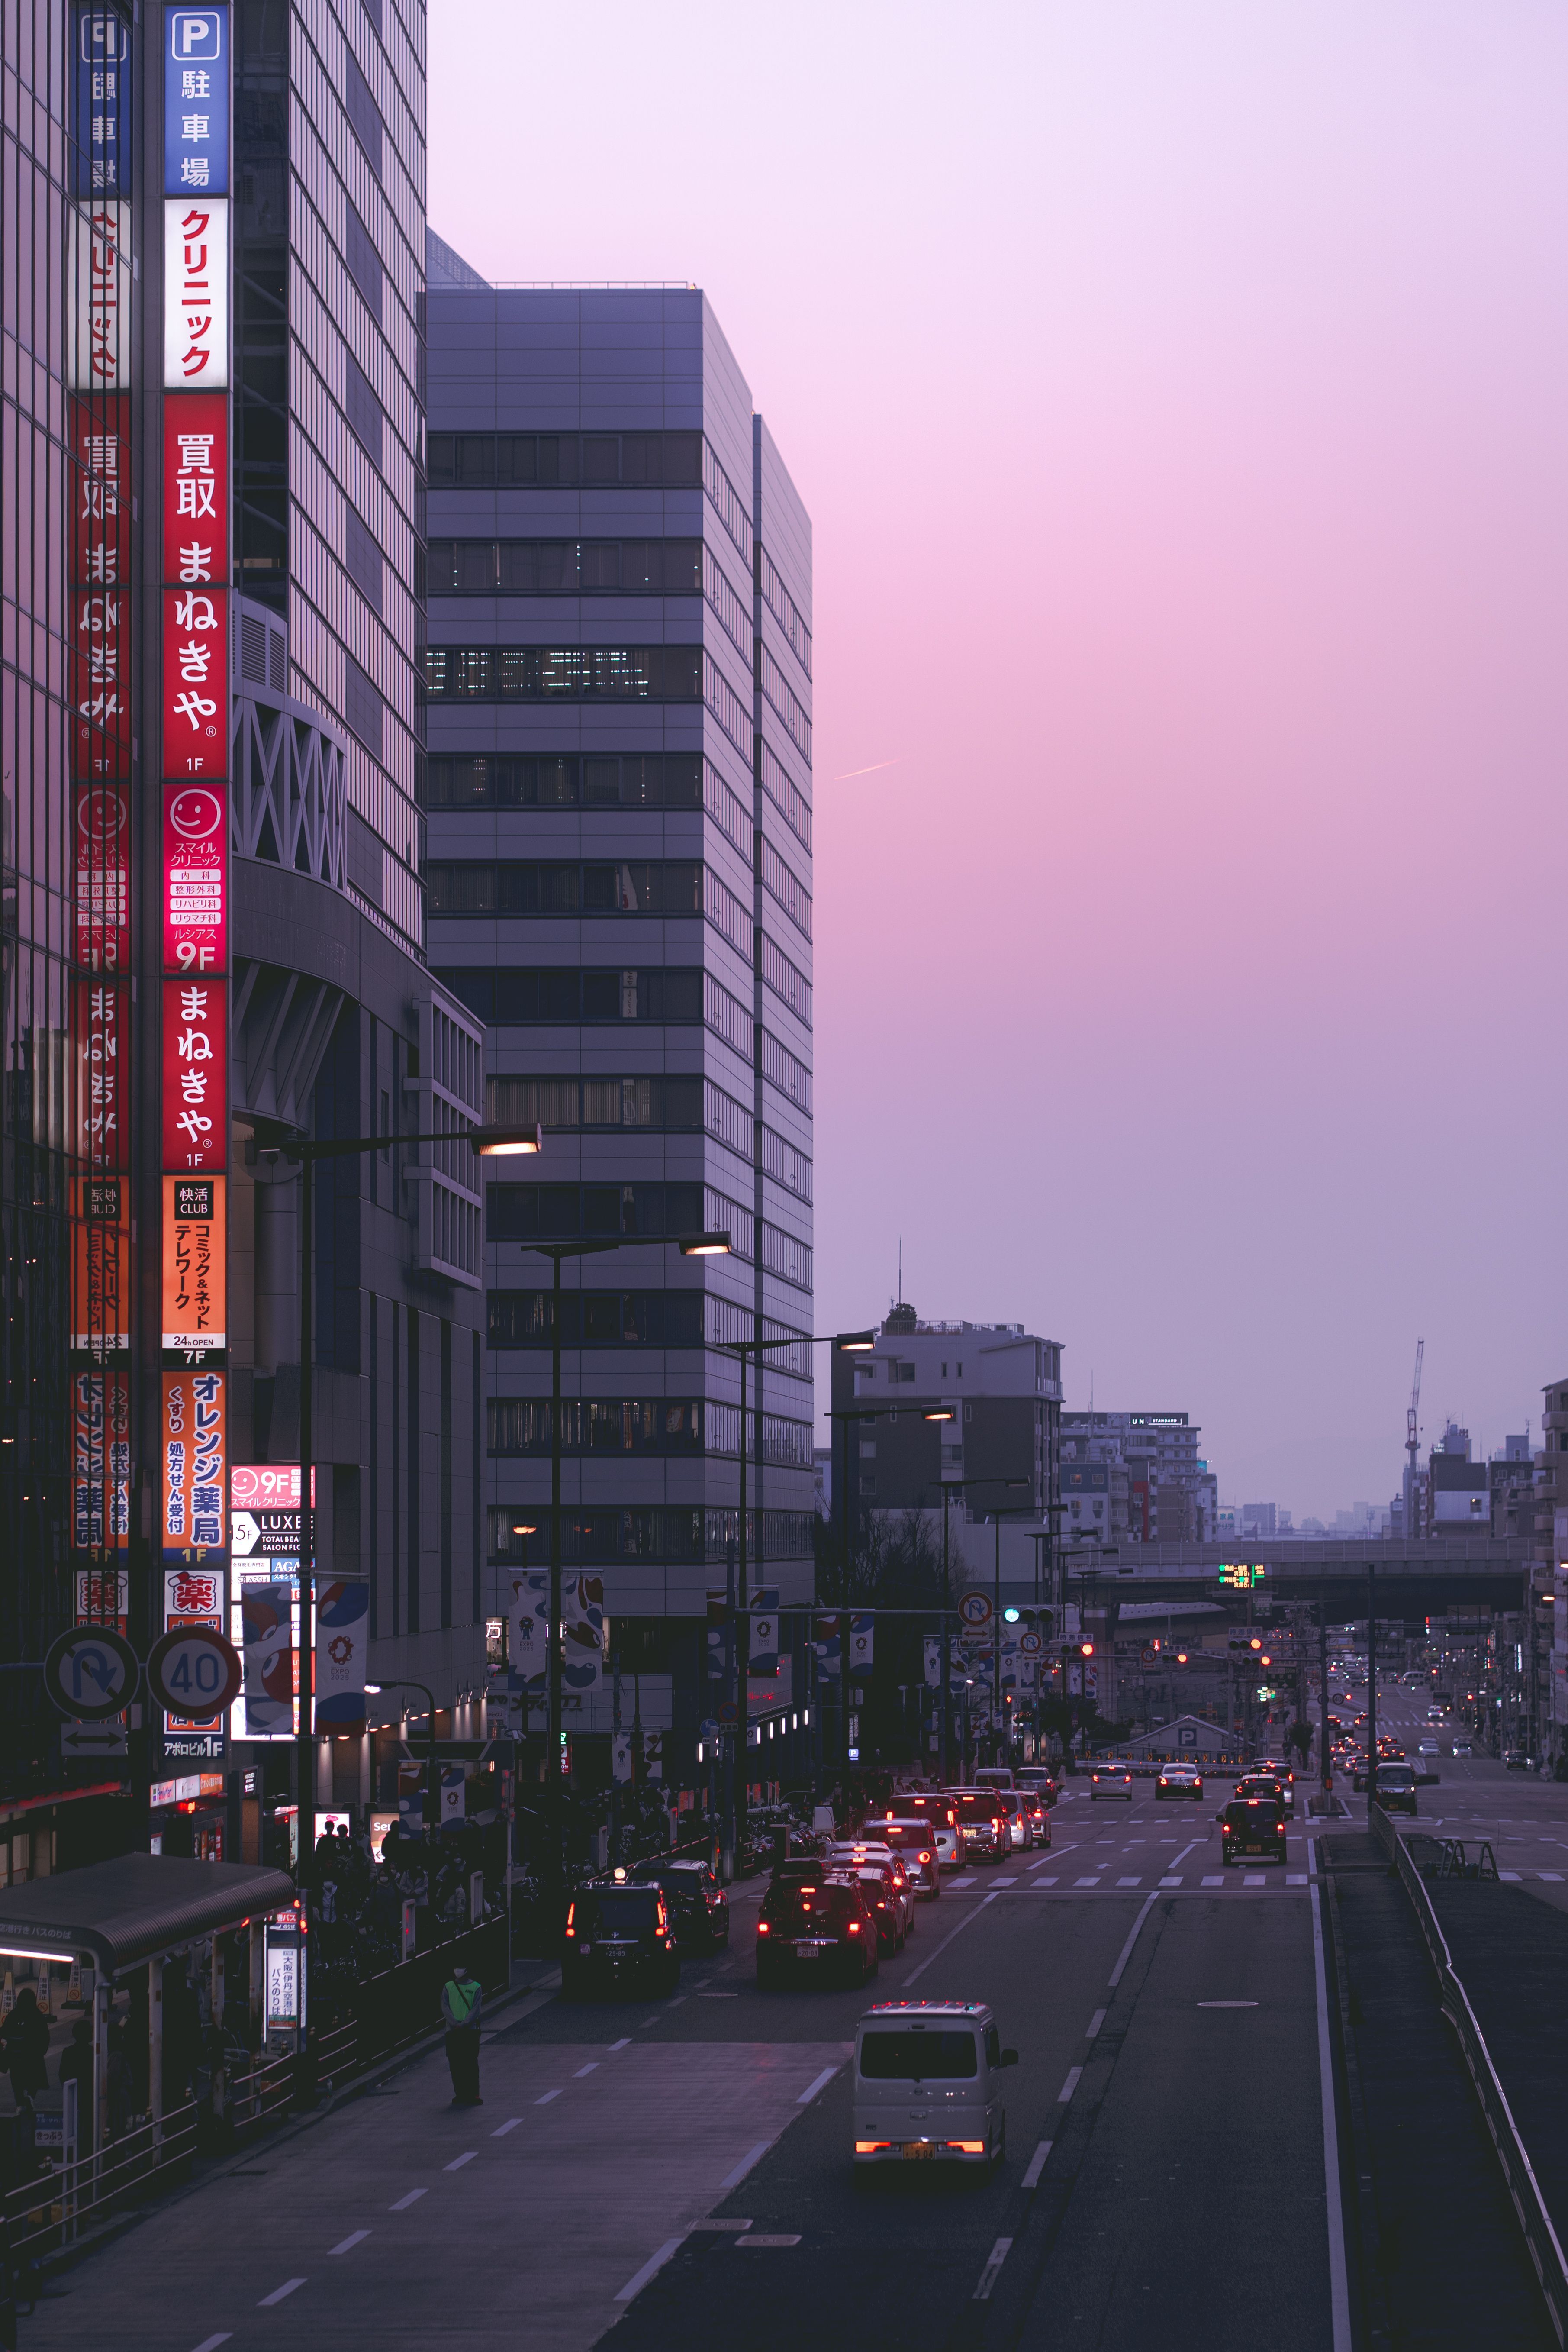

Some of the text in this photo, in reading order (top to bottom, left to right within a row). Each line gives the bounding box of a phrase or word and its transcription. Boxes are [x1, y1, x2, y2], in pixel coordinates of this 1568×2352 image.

[183, 20, 209, 53] P
[181, 71, 210, 186] 駐車場
[181, 210, 212, 377] クリニック
[177, 434, 216, 518] 買取
[174, 542, 218, 731] まねきや
[186, 758, 203, 771] 1F
[175, 842, 216, 853] スマイル
[171, 855, 220, 867] クリニック
[175, 885, 216, 894] 整形外科
[176, 899, 216, 909] リハビリ科
[176, 914, 216, 923] リウマチ科
[174, 929, 216, 939] ルシアス
[176, 941, 215, 970] 9F
[176, 987, 213, 1143] まねきや
[187, 1154, 203, 1166] 1F
[180, 1188, 208, 1201] 快活
[180, 1203, 208, 1213] CLUB
[175, 1225, 191, 1310] テレワーク
[195, 1225, 211, 1329] コミック&ネット
[184, 1350, 206, 1364] 7F
[168, 1387, 184, 1534] くすり 処方せん受付
[192, 1375, 221, 1545] オレンジ薬局
[261, 1471, 289, 1494] 9F
[232, 1497, 300, 1507] スマイルクリニック
[182, 1549, 206, 1562] 1F
[174, 1576, 216, 1612] 薬
[170, 1653, 219, 1693] 40
[164, 1736, 222, 1757] アポロビル1F
[1181, 1730, 1195, 1745] P
[32, 1926, 72, 1940] バスのりば
[272, 1968, 281, 2016] バスのりば
